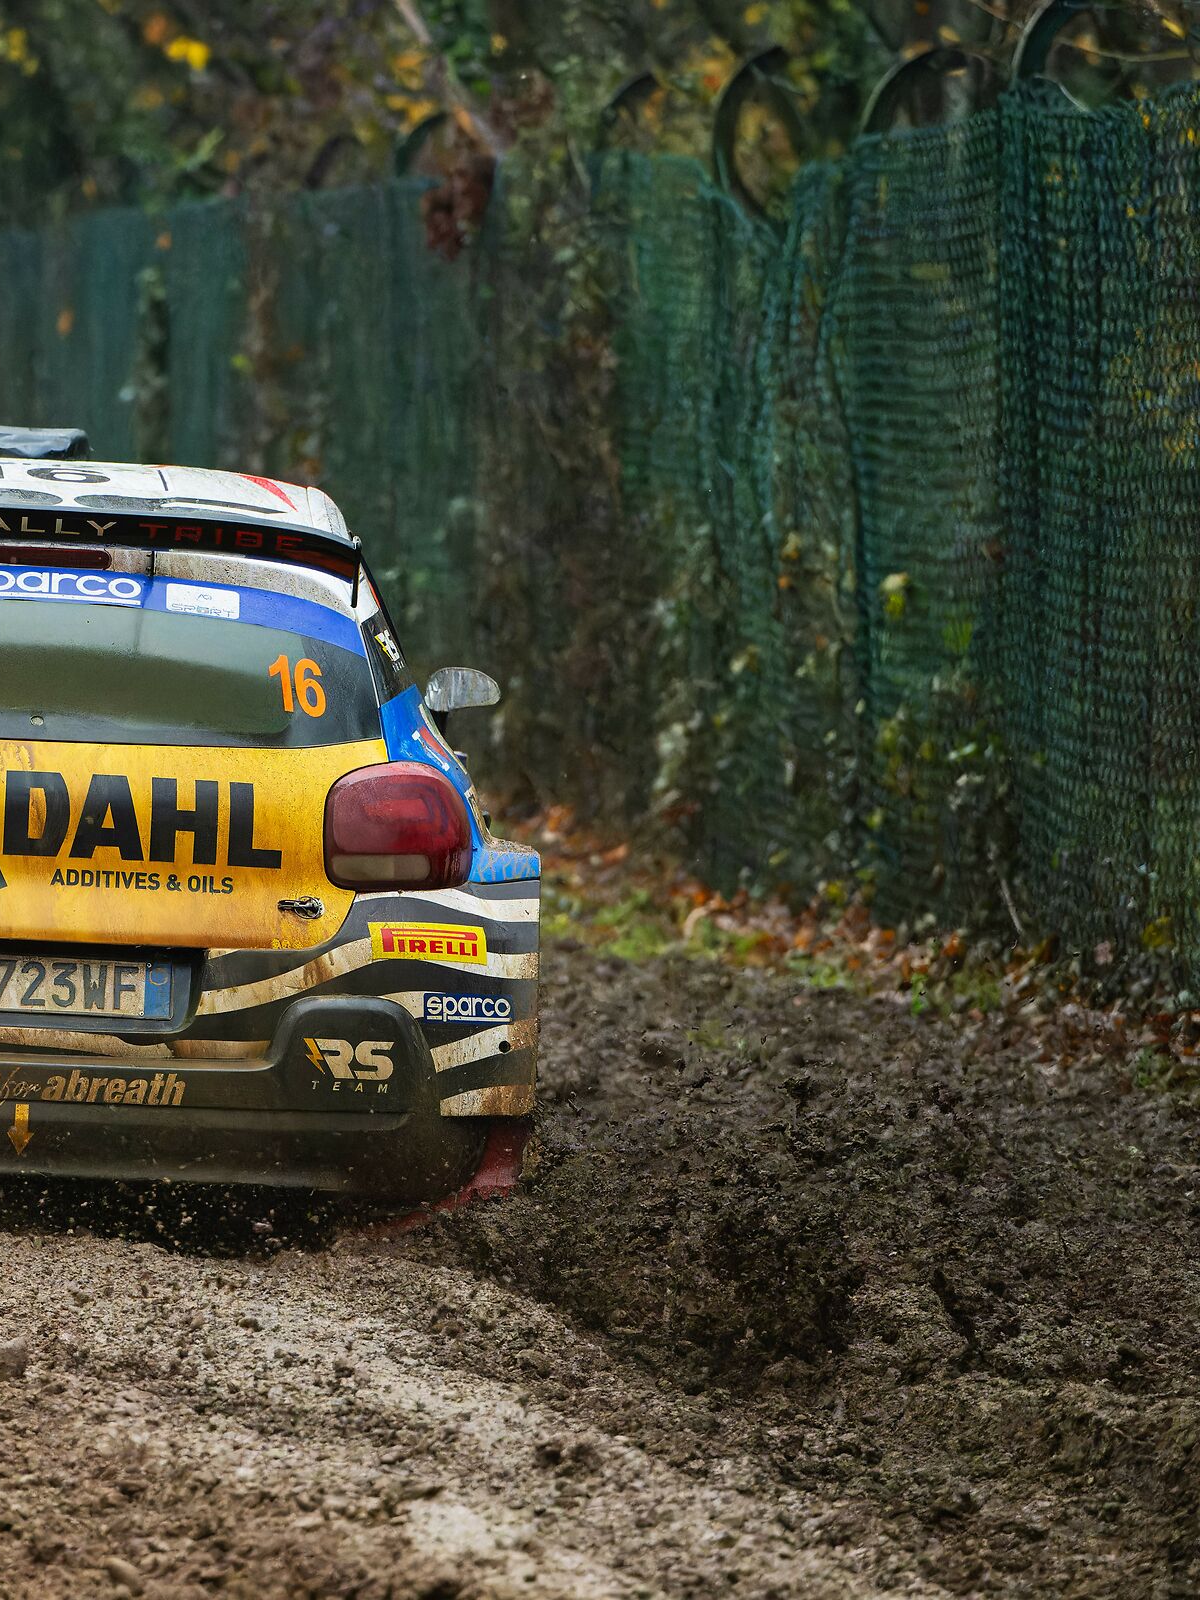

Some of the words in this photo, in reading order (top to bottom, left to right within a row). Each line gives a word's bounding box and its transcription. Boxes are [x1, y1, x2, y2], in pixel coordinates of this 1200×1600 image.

[139, 523, 304, 551] TRIBE
[268, 654, 327, 718] 16
[51, 868, 161, 891] ADDITIVES
[166, 874, 182, 892] &
[187, 875, 234, 894] OILS
[380, 928, 478, 957] PIRELLI
[426, 995, 511, 1022] sparco
[311, 1038, 396, 1081] RS
[41, 1069, 186, 1106] abreath
[311, 1080, 390, 1094] TEAM
